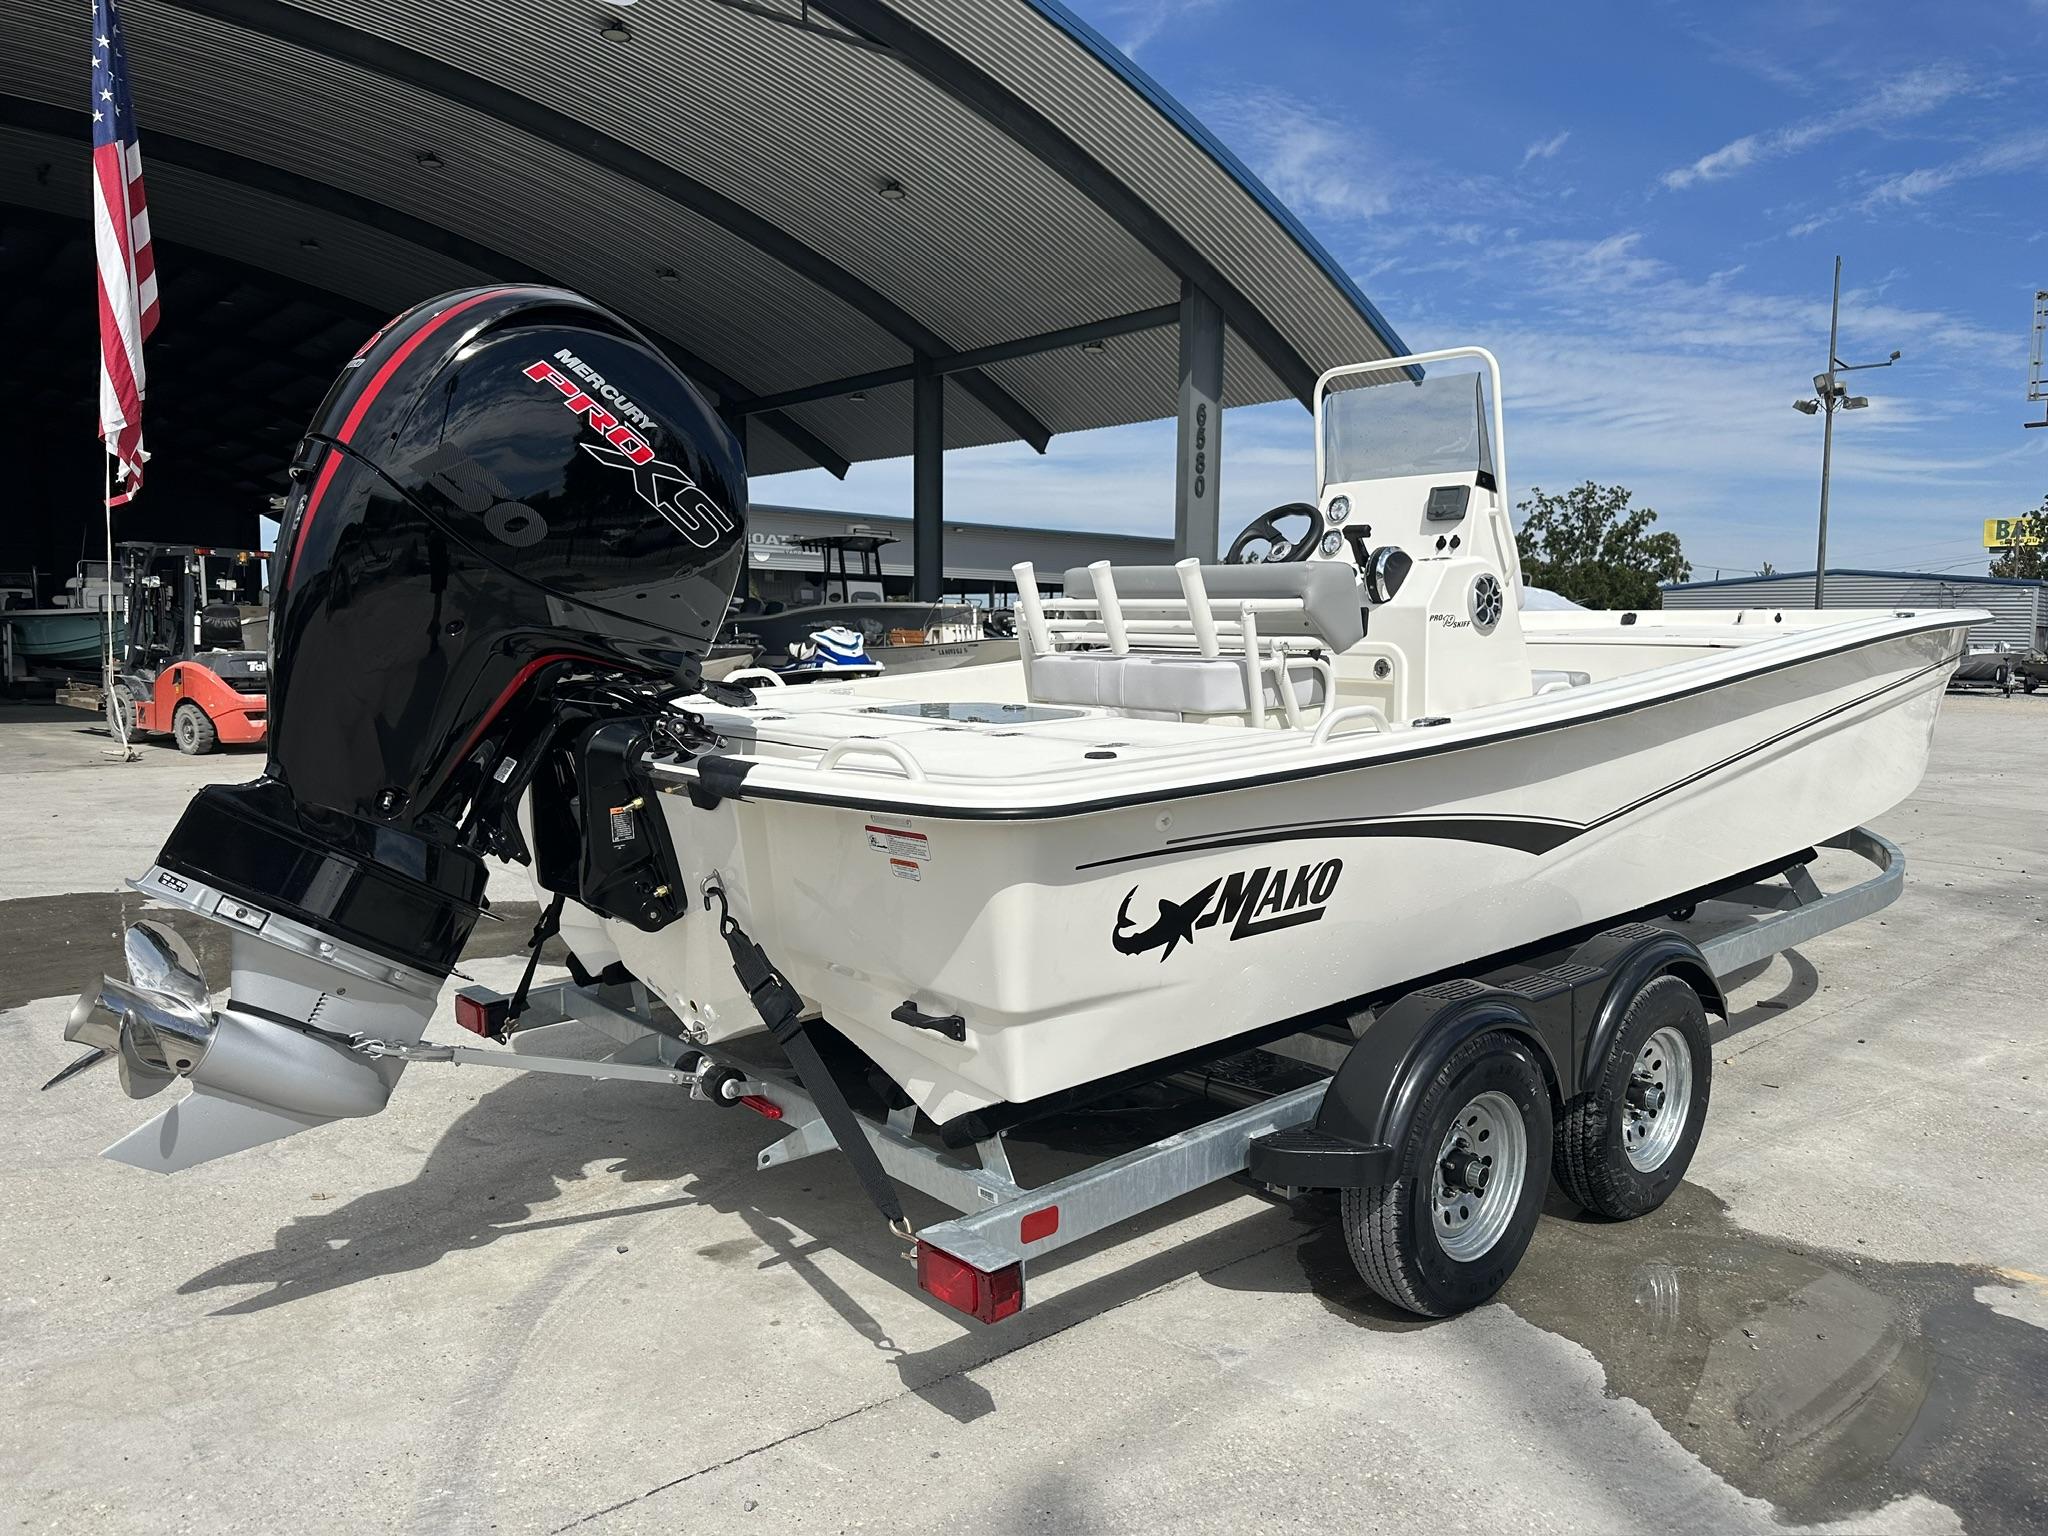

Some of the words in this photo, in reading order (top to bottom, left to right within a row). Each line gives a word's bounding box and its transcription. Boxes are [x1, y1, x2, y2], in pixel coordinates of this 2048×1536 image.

[522, 360, 655, 465] PRO
[554, 349, 658, 429] MERCURY
[1194, 403, 1207, 498] 6580
[1429, 614, 1443, 622] PRO
[1195, 858, 1344, 942] MAKO
